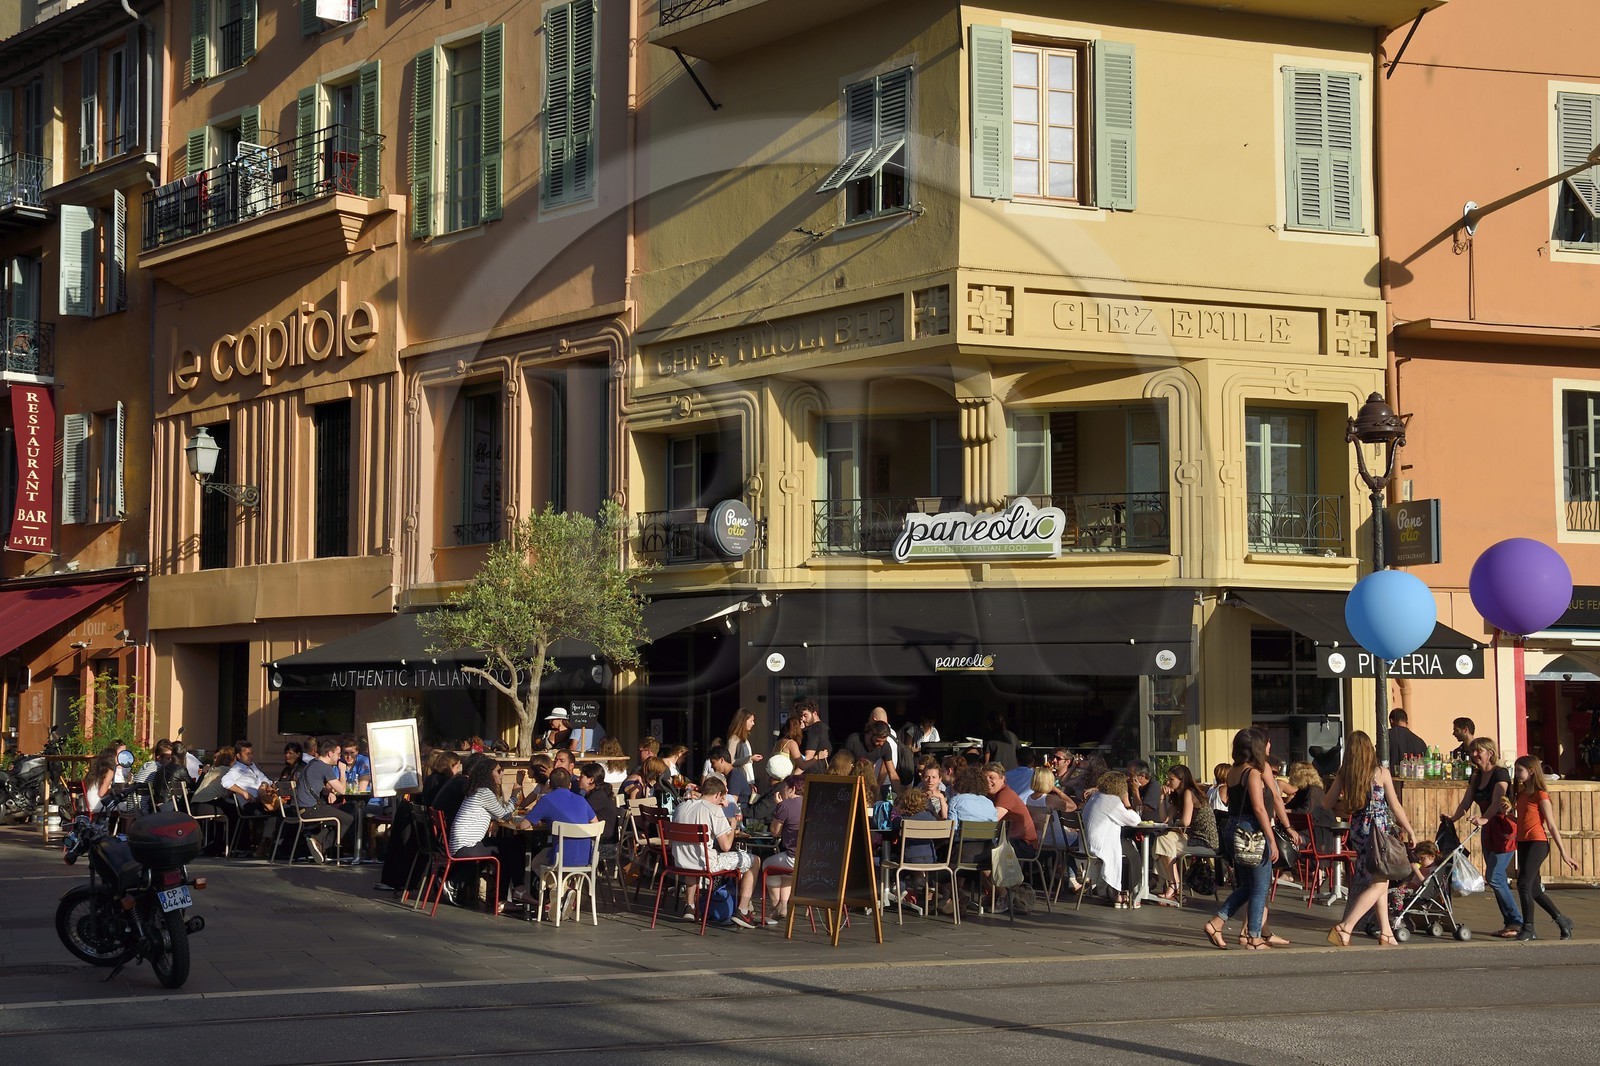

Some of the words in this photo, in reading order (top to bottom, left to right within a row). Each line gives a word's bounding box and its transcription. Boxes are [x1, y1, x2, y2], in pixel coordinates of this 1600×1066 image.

[834, 306, 895, 345] BAR
[1052, 299, 1158, 337] CHEZ
[1171, 307, 1293, 345] EMILE
[168, 324, 201, 395] le
[210, 282, 380, 386] capitole
[26, 391, 40, 502] RESTAURANT
[16, 508, 48, 524] BAR
[725, 508, 749, 527] Pane
[1396, 508, 1423, 530] Pane
[727, 523, 747, 537] olio
[23, 535, 47, 547] VLT
[922, 545, 968, 554] AUTHENTIC
[970, 545, 1001, 553] ITALIAN
[1004, 544, 1029, 552] FOOD
[1397, 552, 1426, 561] RESTAURANT
[1358, 653, 1444, 675] PIZERIA
[331, 669, 408, 688] AUTHENTIC
[414, 669, 471, 687] ITALIAN
[162, 895, 192, 910] 044-WC
